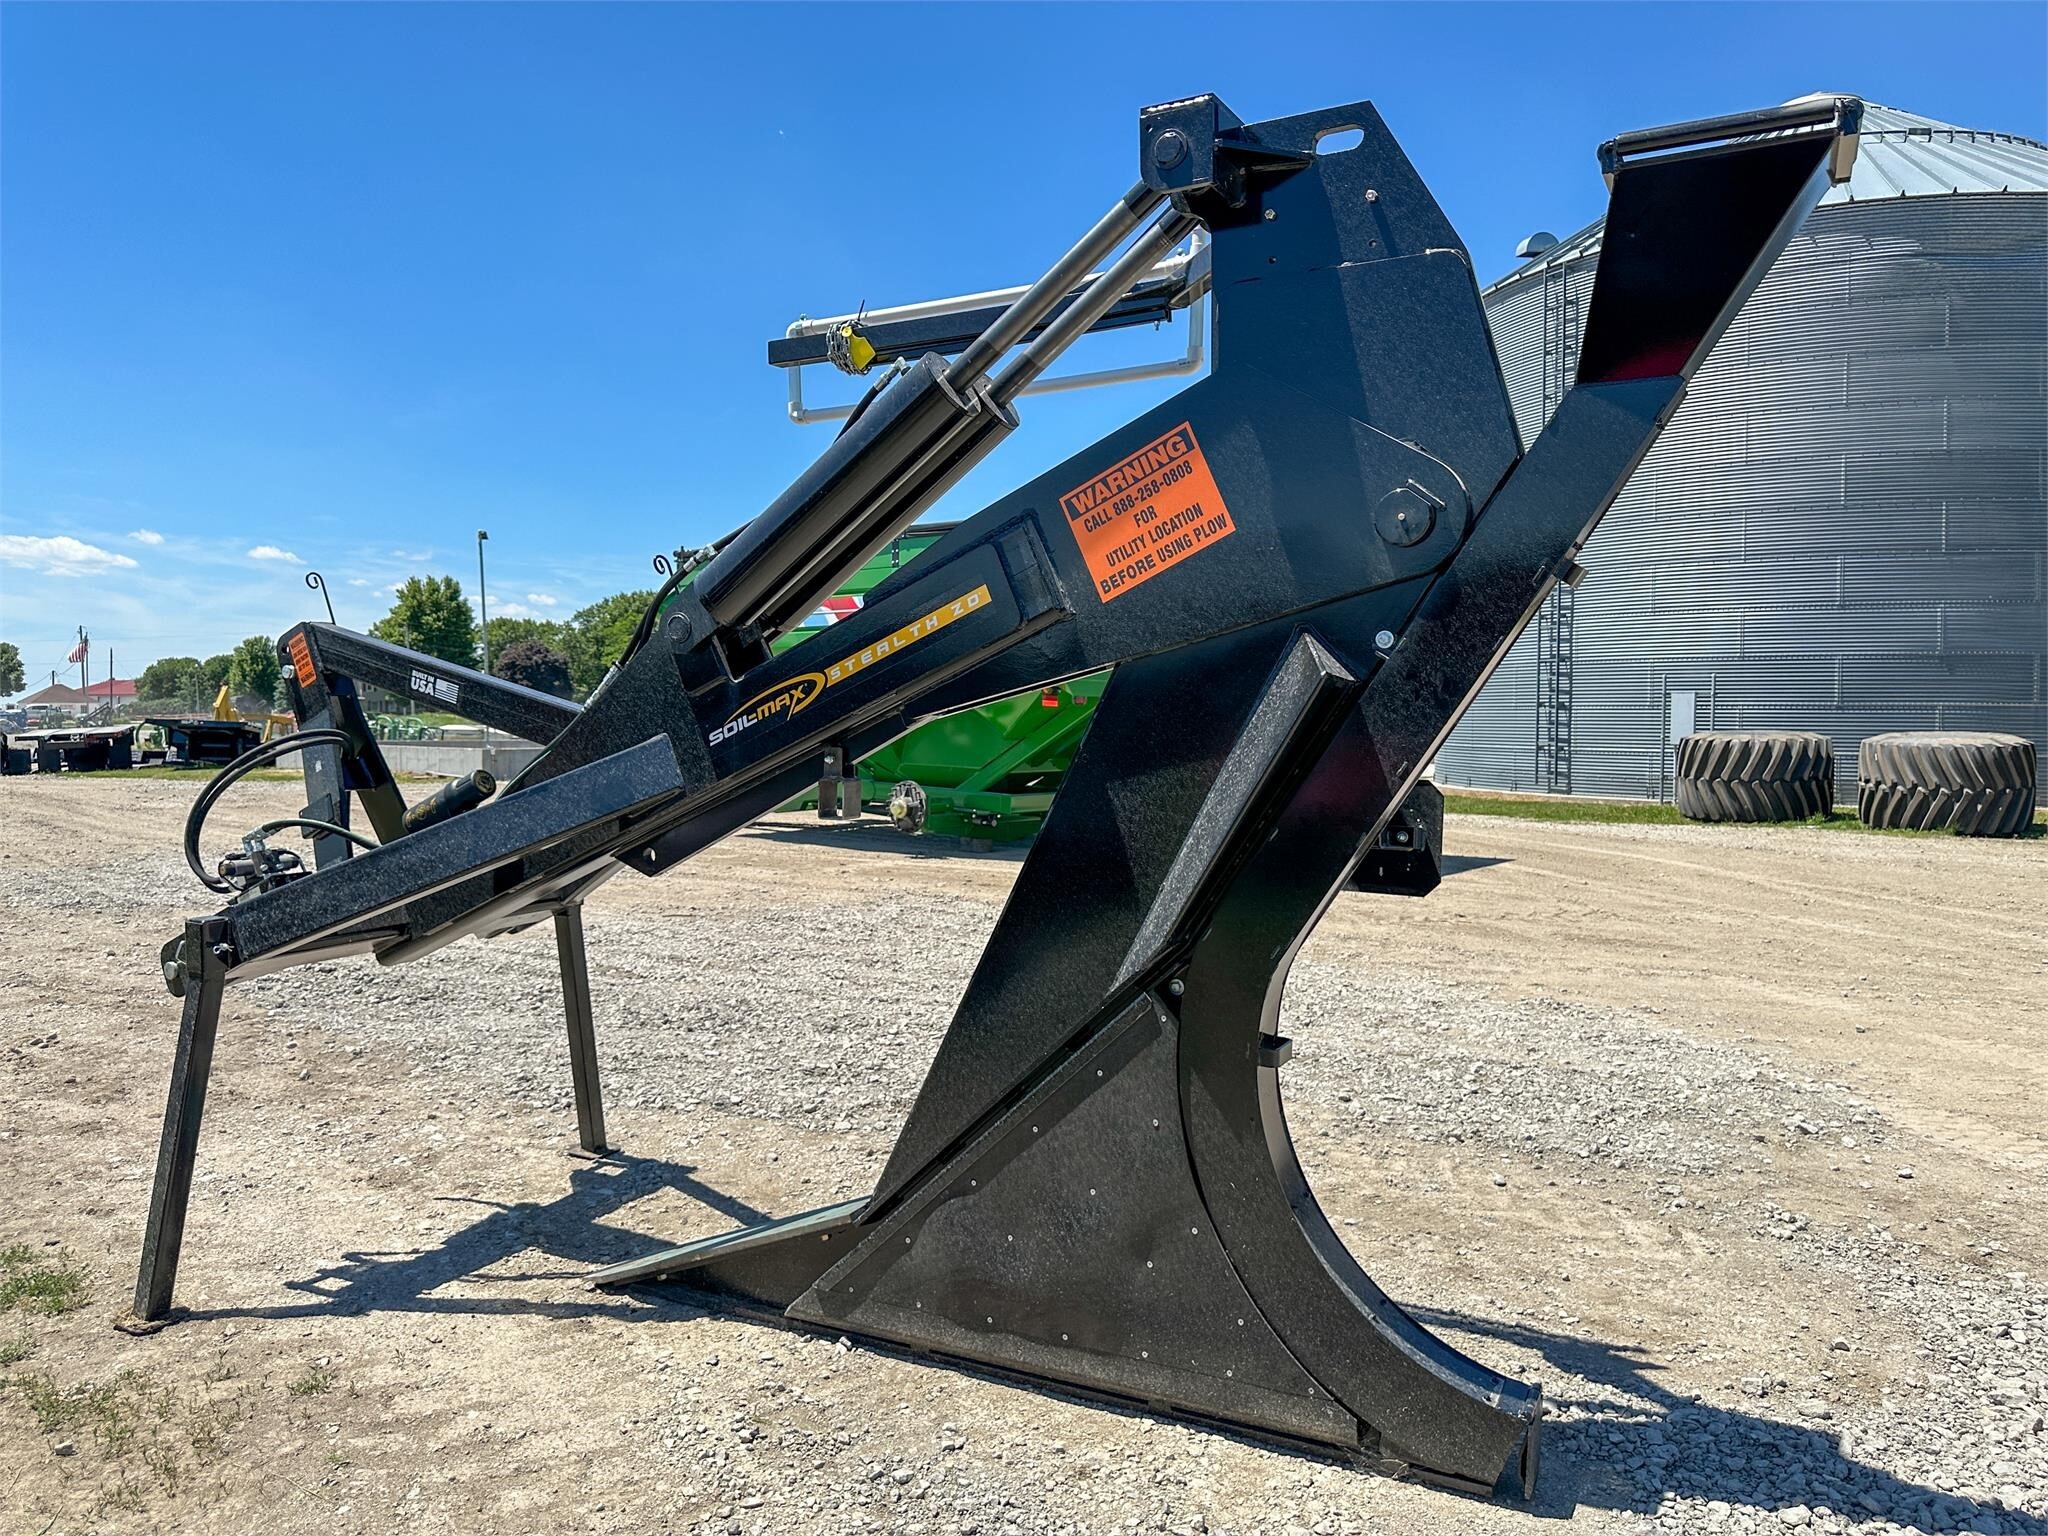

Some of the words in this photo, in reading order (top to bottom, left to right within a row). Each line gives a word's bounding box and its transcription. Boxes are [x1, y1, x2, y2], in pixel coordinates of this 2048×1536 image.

[1071, 435, 1188, 514] WARNING
[1084, 509, 1112, 533] CALL
[1113, 460, 1193, 516] 888-258-0808
[1106, 535, 1146, 567] UTILITY
[1148, 503, 1204, 543] LOCATION
[1133, 505, 1158, 528] FOR
[1100, 554, 1156, 594] BEFORE
[1157, 533, 1193, 563] USING
[1193, 513, 1227, 543] PLOW
[412, 669, 427, 680] BUILT
[831, 618, 938, 679] STEALTH
[411, 677, 434, 696] USA
[708, 684, 806, 747] SOIL-MAX
